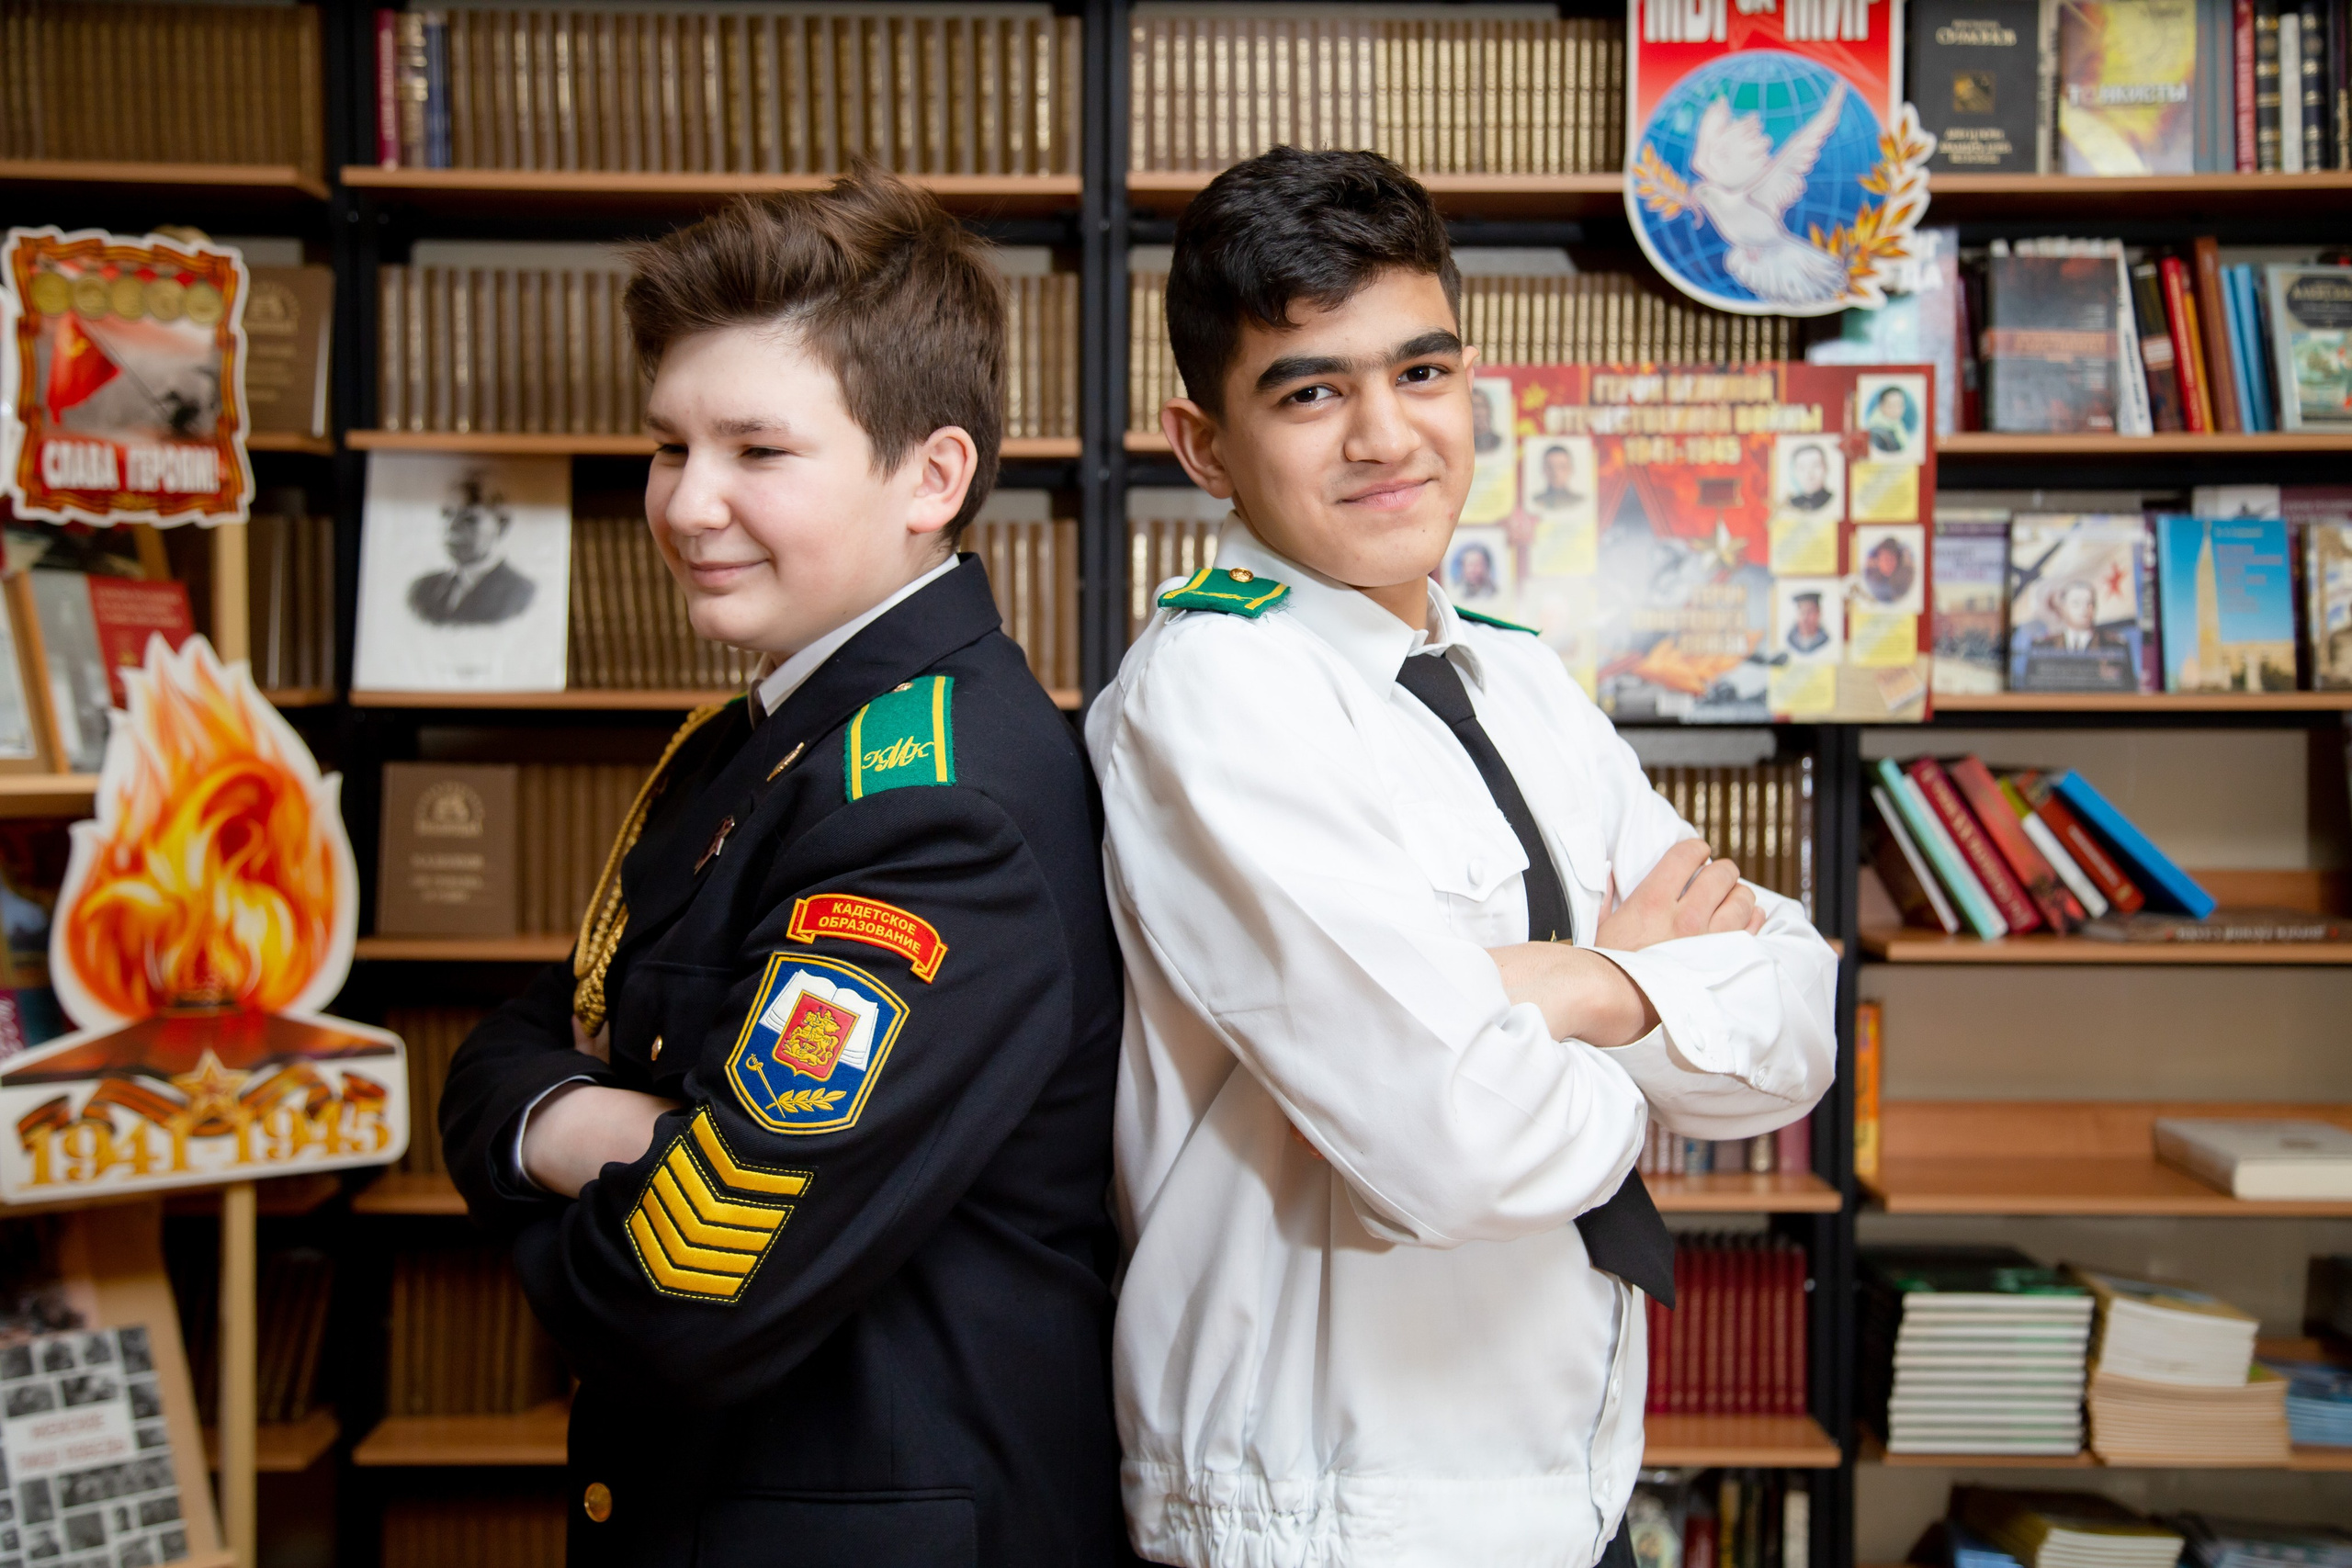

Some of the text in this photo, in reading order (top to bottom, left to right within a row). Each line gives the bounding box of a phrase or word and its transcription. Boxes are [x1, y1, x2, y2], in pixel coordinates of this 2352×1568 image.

[41, 440, 120, 491] СЛАВА
[818, 915, 922, 954] ОБРАЗОВАНИЕ
[831, 901, 918, 936] КАДЕТСКОЕ
